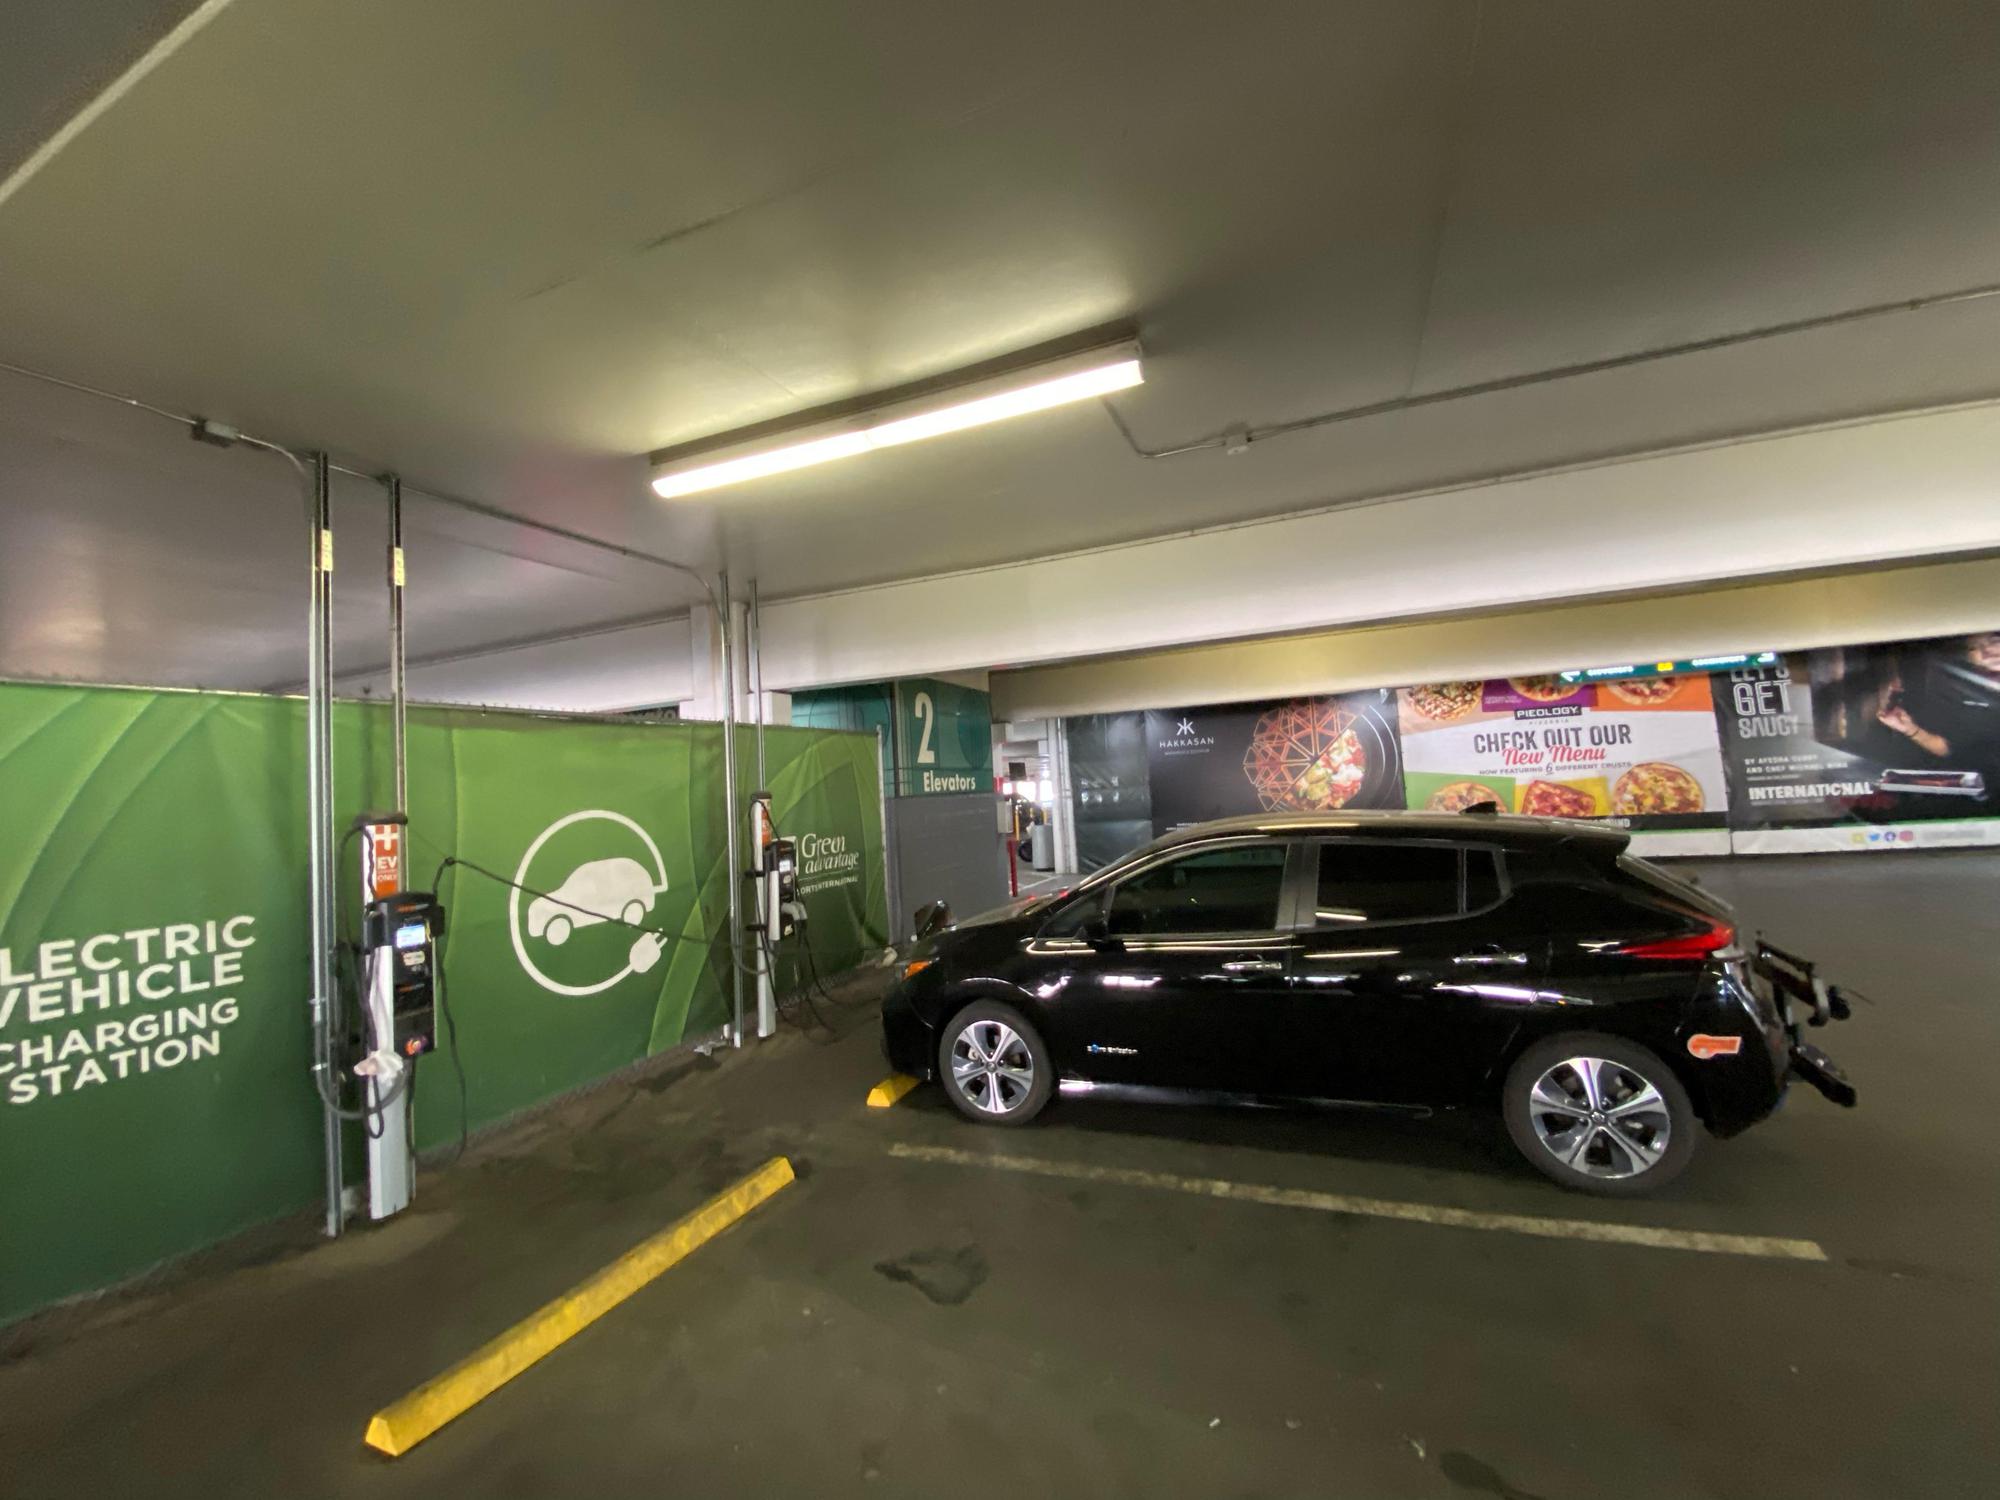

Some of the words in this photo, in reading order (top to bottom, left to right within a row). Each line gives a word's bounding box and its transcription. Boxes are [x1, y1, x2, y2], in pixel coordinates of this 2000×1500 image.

[1733, 679, 1793, 716] GET
[1517, 706, 1579, 718] PIEOLOGY
[915, 691, 935, 764] 2
[1738, 714, 1799, 739] SAUCY
[1159, 737, 1215, 748] HAKKASAN
[1473, 729, 1538, 754] CHECK
[1543, 727, 1582, 748] OUT
[1589, 723, 1632, 746] OUR
[1502, 746, 1544, 766] New
[1548, 744, 1606, 763] Menu
[1545, 762, 1553, 775] 6
[923, 770, 976, 793] Elevators
[1748, 782, 1874, 800] INTERNATIONAL
[377, 855, 398, 870] EV
[10, 1030, 220, 1104] STATION
